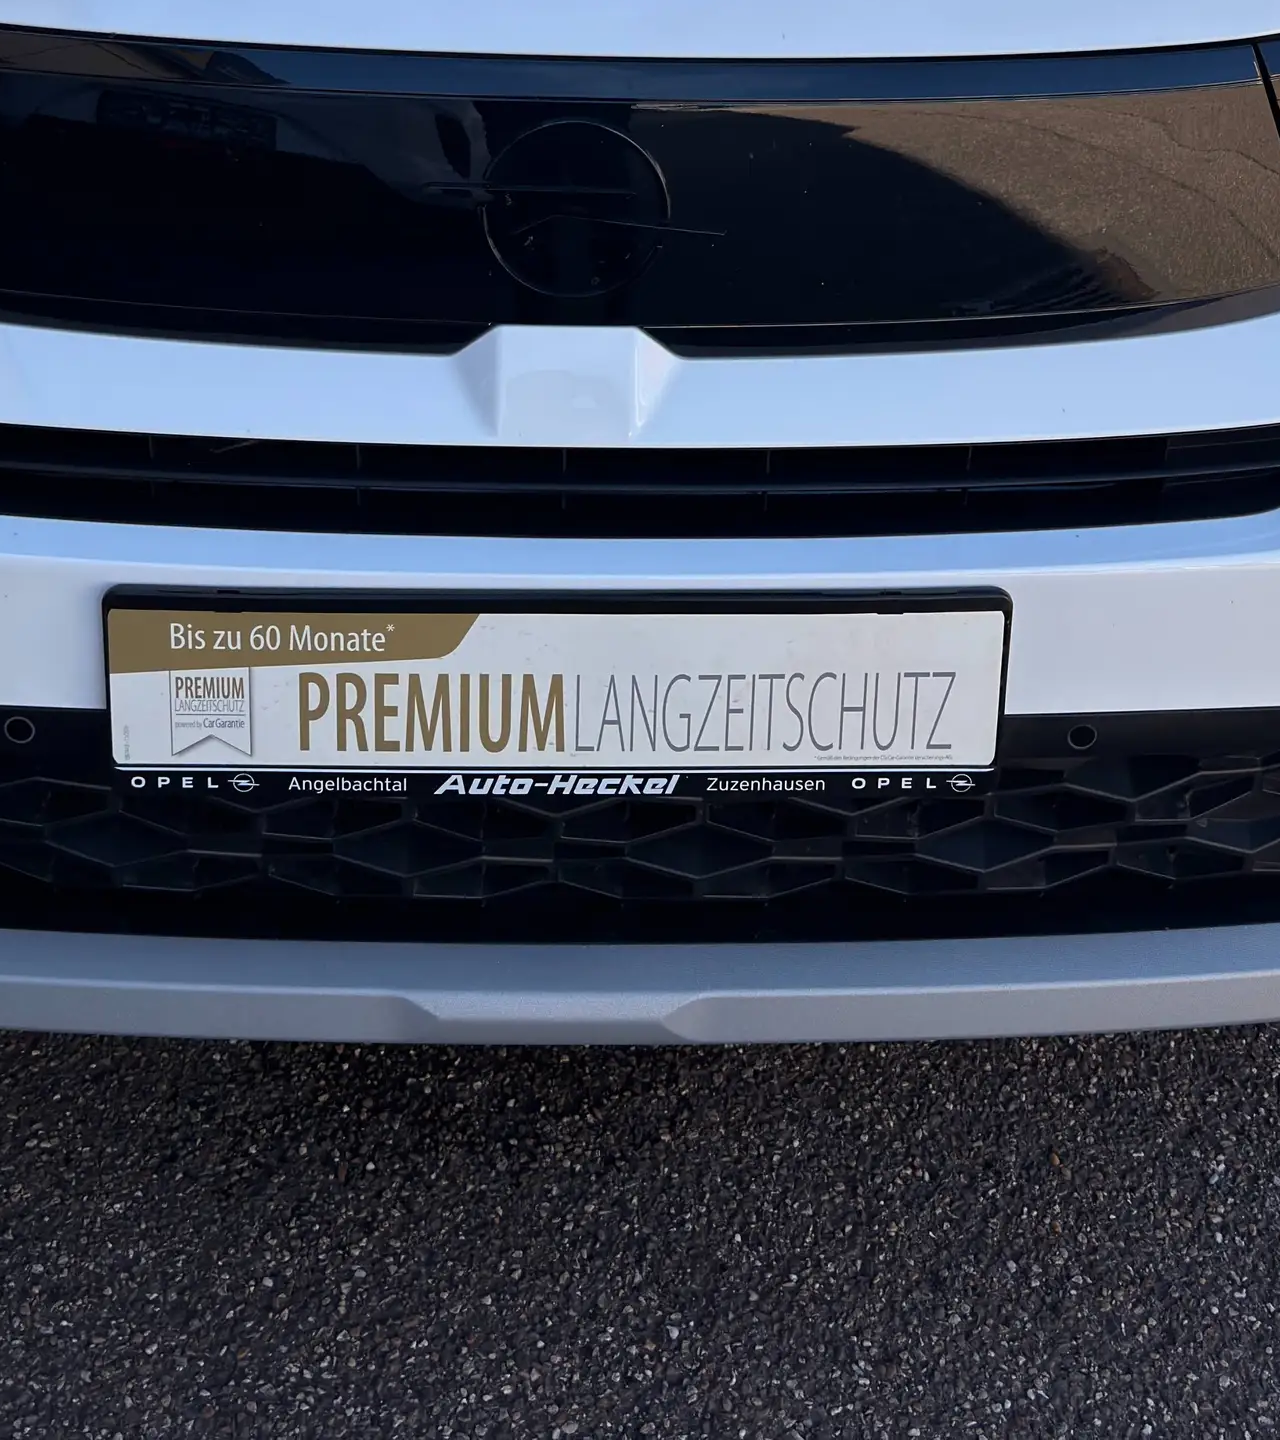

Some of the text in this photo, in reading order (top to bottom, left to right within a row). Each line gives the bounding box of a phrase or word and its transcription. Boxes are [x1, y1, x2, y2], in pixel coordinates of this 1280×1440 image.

[170, 622, 206, 650] Bis
[213, 629, 242, 650] zu
[249, 624, 281, 651] 60
[175, 676, 245, 699] PREMIUM
[174, 698, 245, 712] LANGZEITSCHUTZ
[130, 774, 937, 796] OPEL Angelbachtal Auto-Heckel Zuzenhausen OPEL
